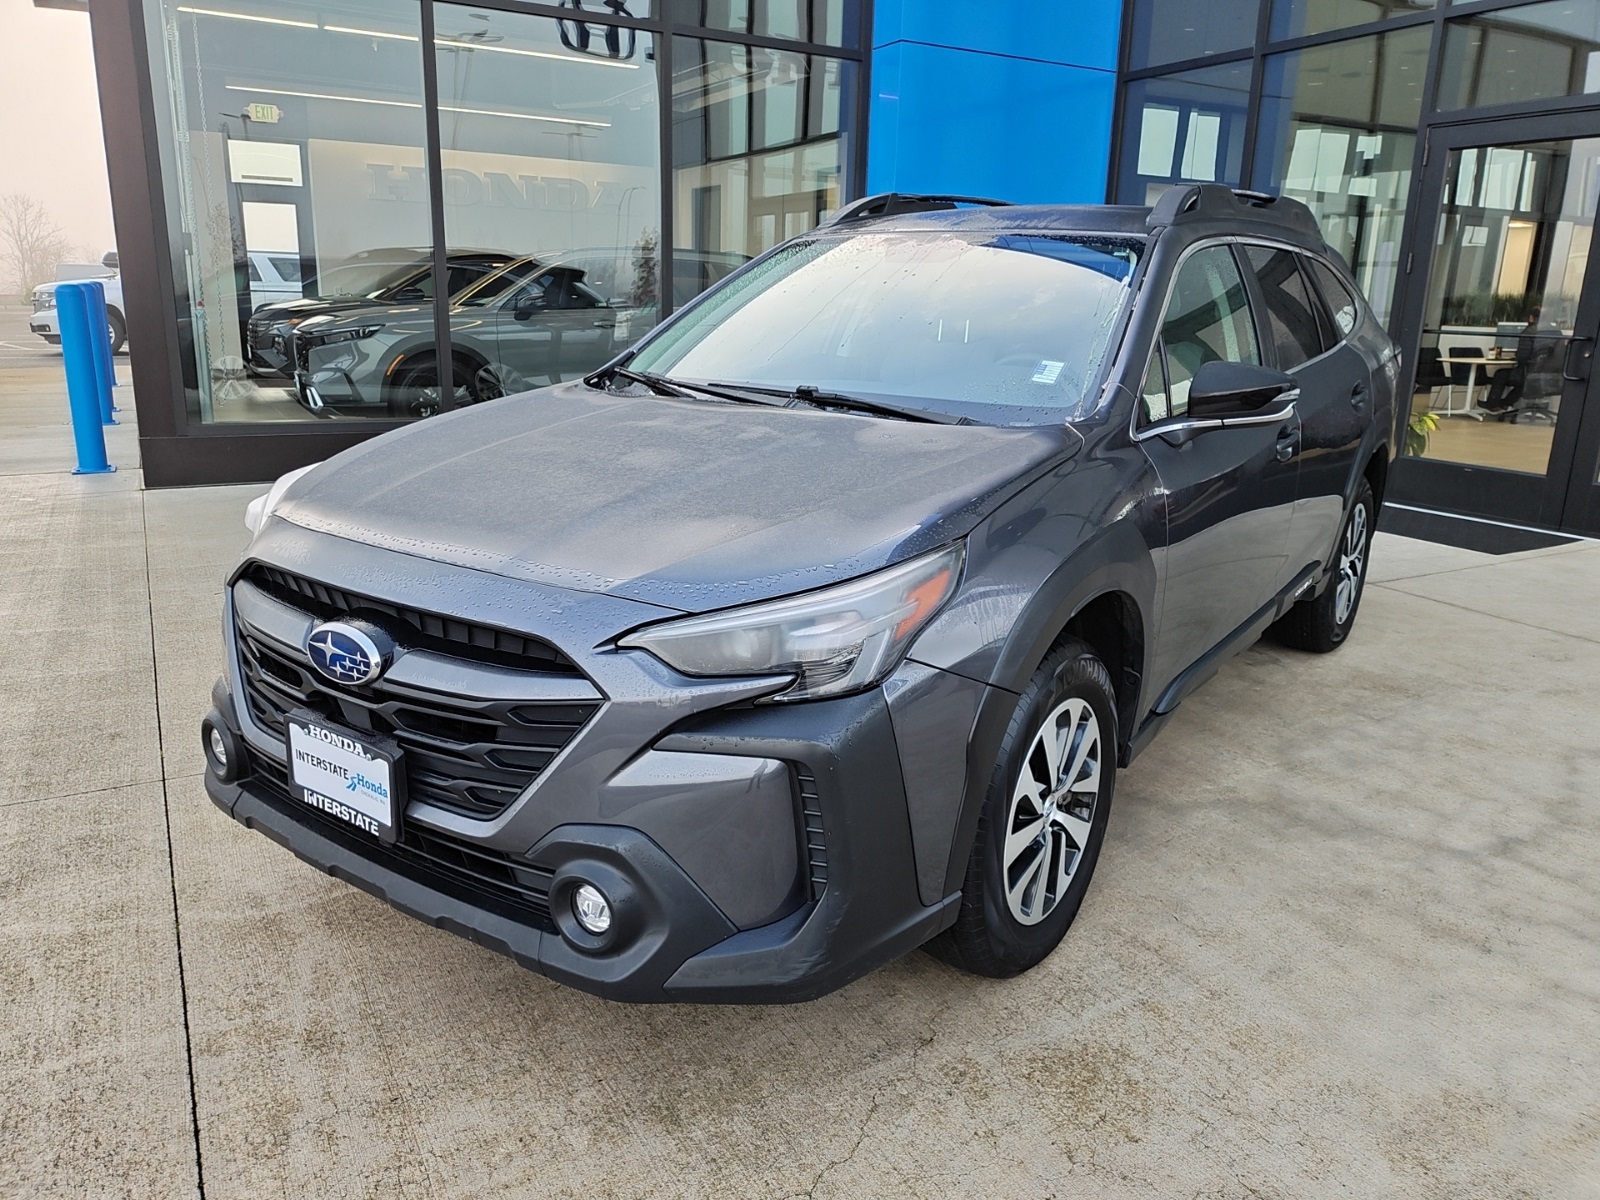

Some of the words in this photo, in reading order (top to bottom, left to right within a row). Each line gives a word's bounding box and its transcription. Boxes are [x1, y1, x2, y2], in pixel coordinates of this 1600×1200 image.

[255, 105, 273, 119] EXIT
[366, 163, 642, 216] HONDA
[308, 724, 365, 757] HONDA
[296, 749, 349, 780] INTERSTATE
[356, 773, 388, 798] Honda
[304, 789, 379, 836] INTERSTATE
